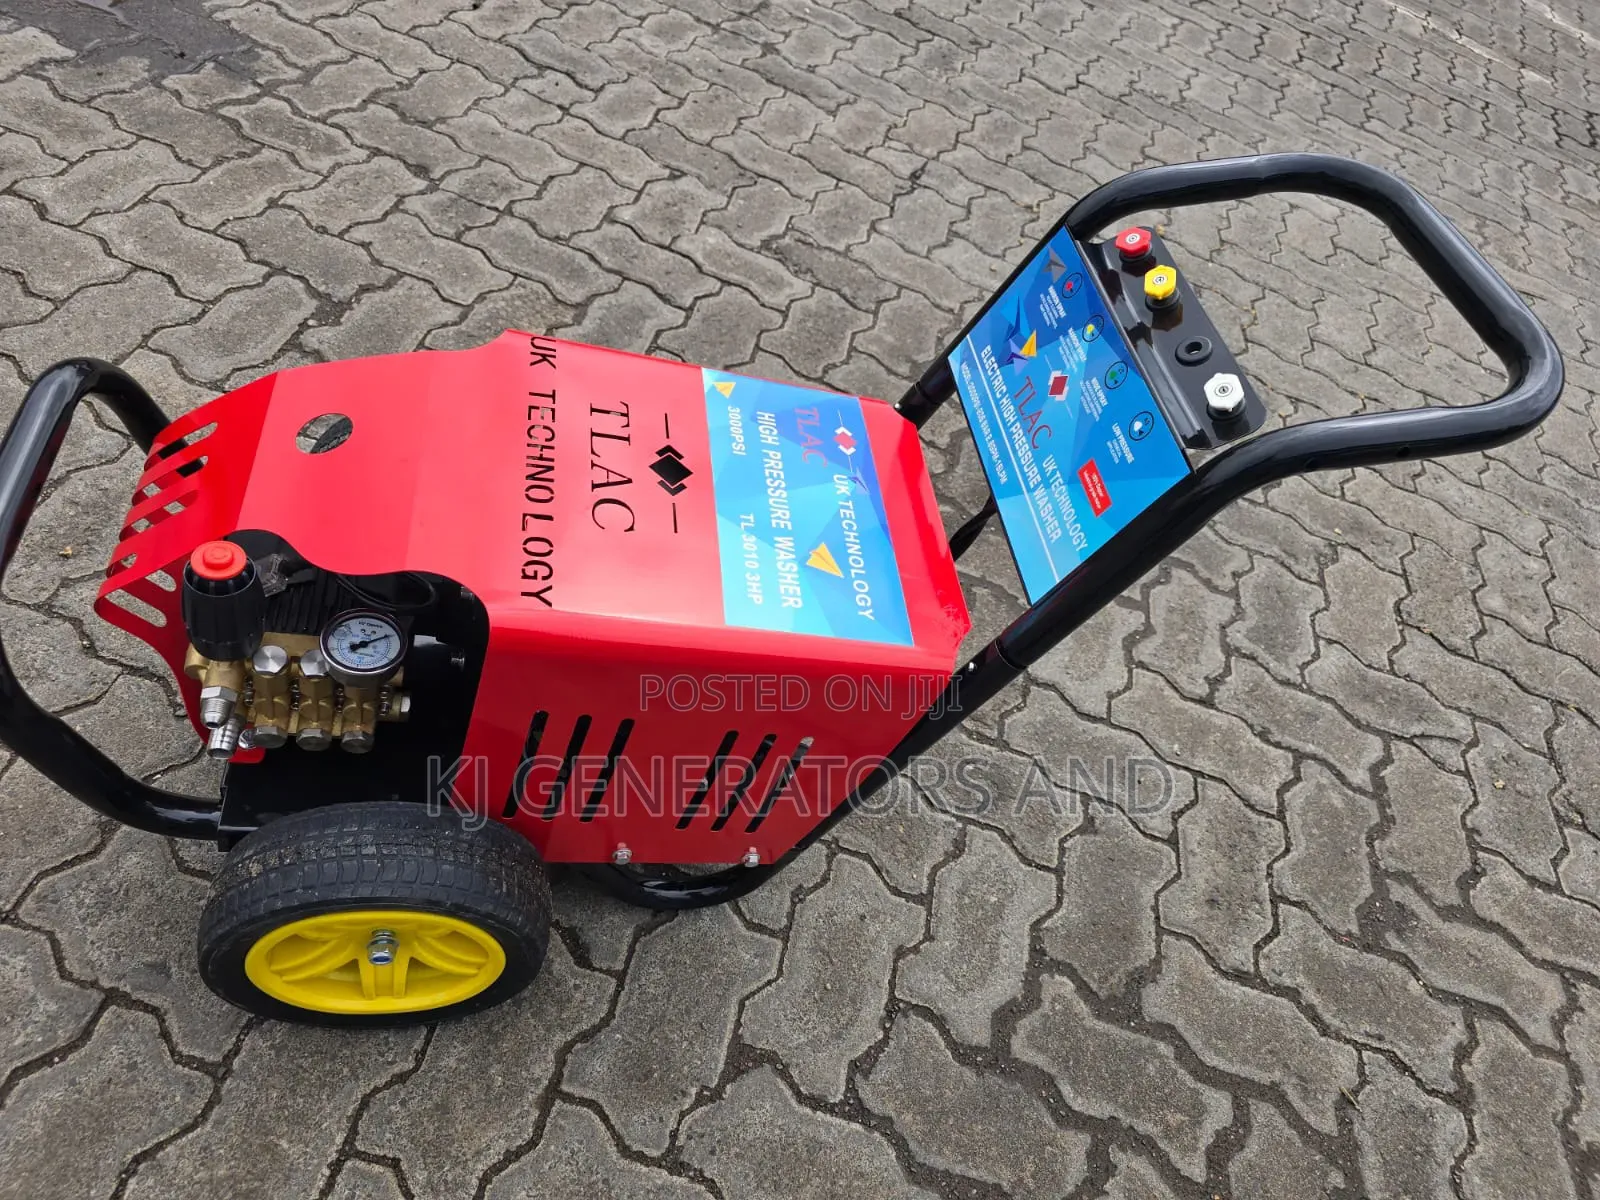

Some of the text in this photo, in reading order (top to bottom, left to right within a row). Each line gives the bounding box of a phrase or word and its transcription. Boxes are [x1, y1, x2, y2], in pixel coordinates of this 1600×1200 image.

[529, 336, 557, 369] UK
[727, 405, 746, 455] 3000PSI
[794, 404, 828, 468] TLAC
[980, 345, 1062, 543] ELECTRIC HIGH PRESSURE WASHER
[1012, 375, 1052, 450] TLAC
[590, 400, 636, 533] TLAC
[756, 410, 803, 609] HIGH PRESSURE WASHER
[1042, 454, 1088, 552] UK TECHNOLOGY
[738, 512, 763, 605] TL 3010 3HP
[832, 473, 874, 620] UK TECHNOLOGY
